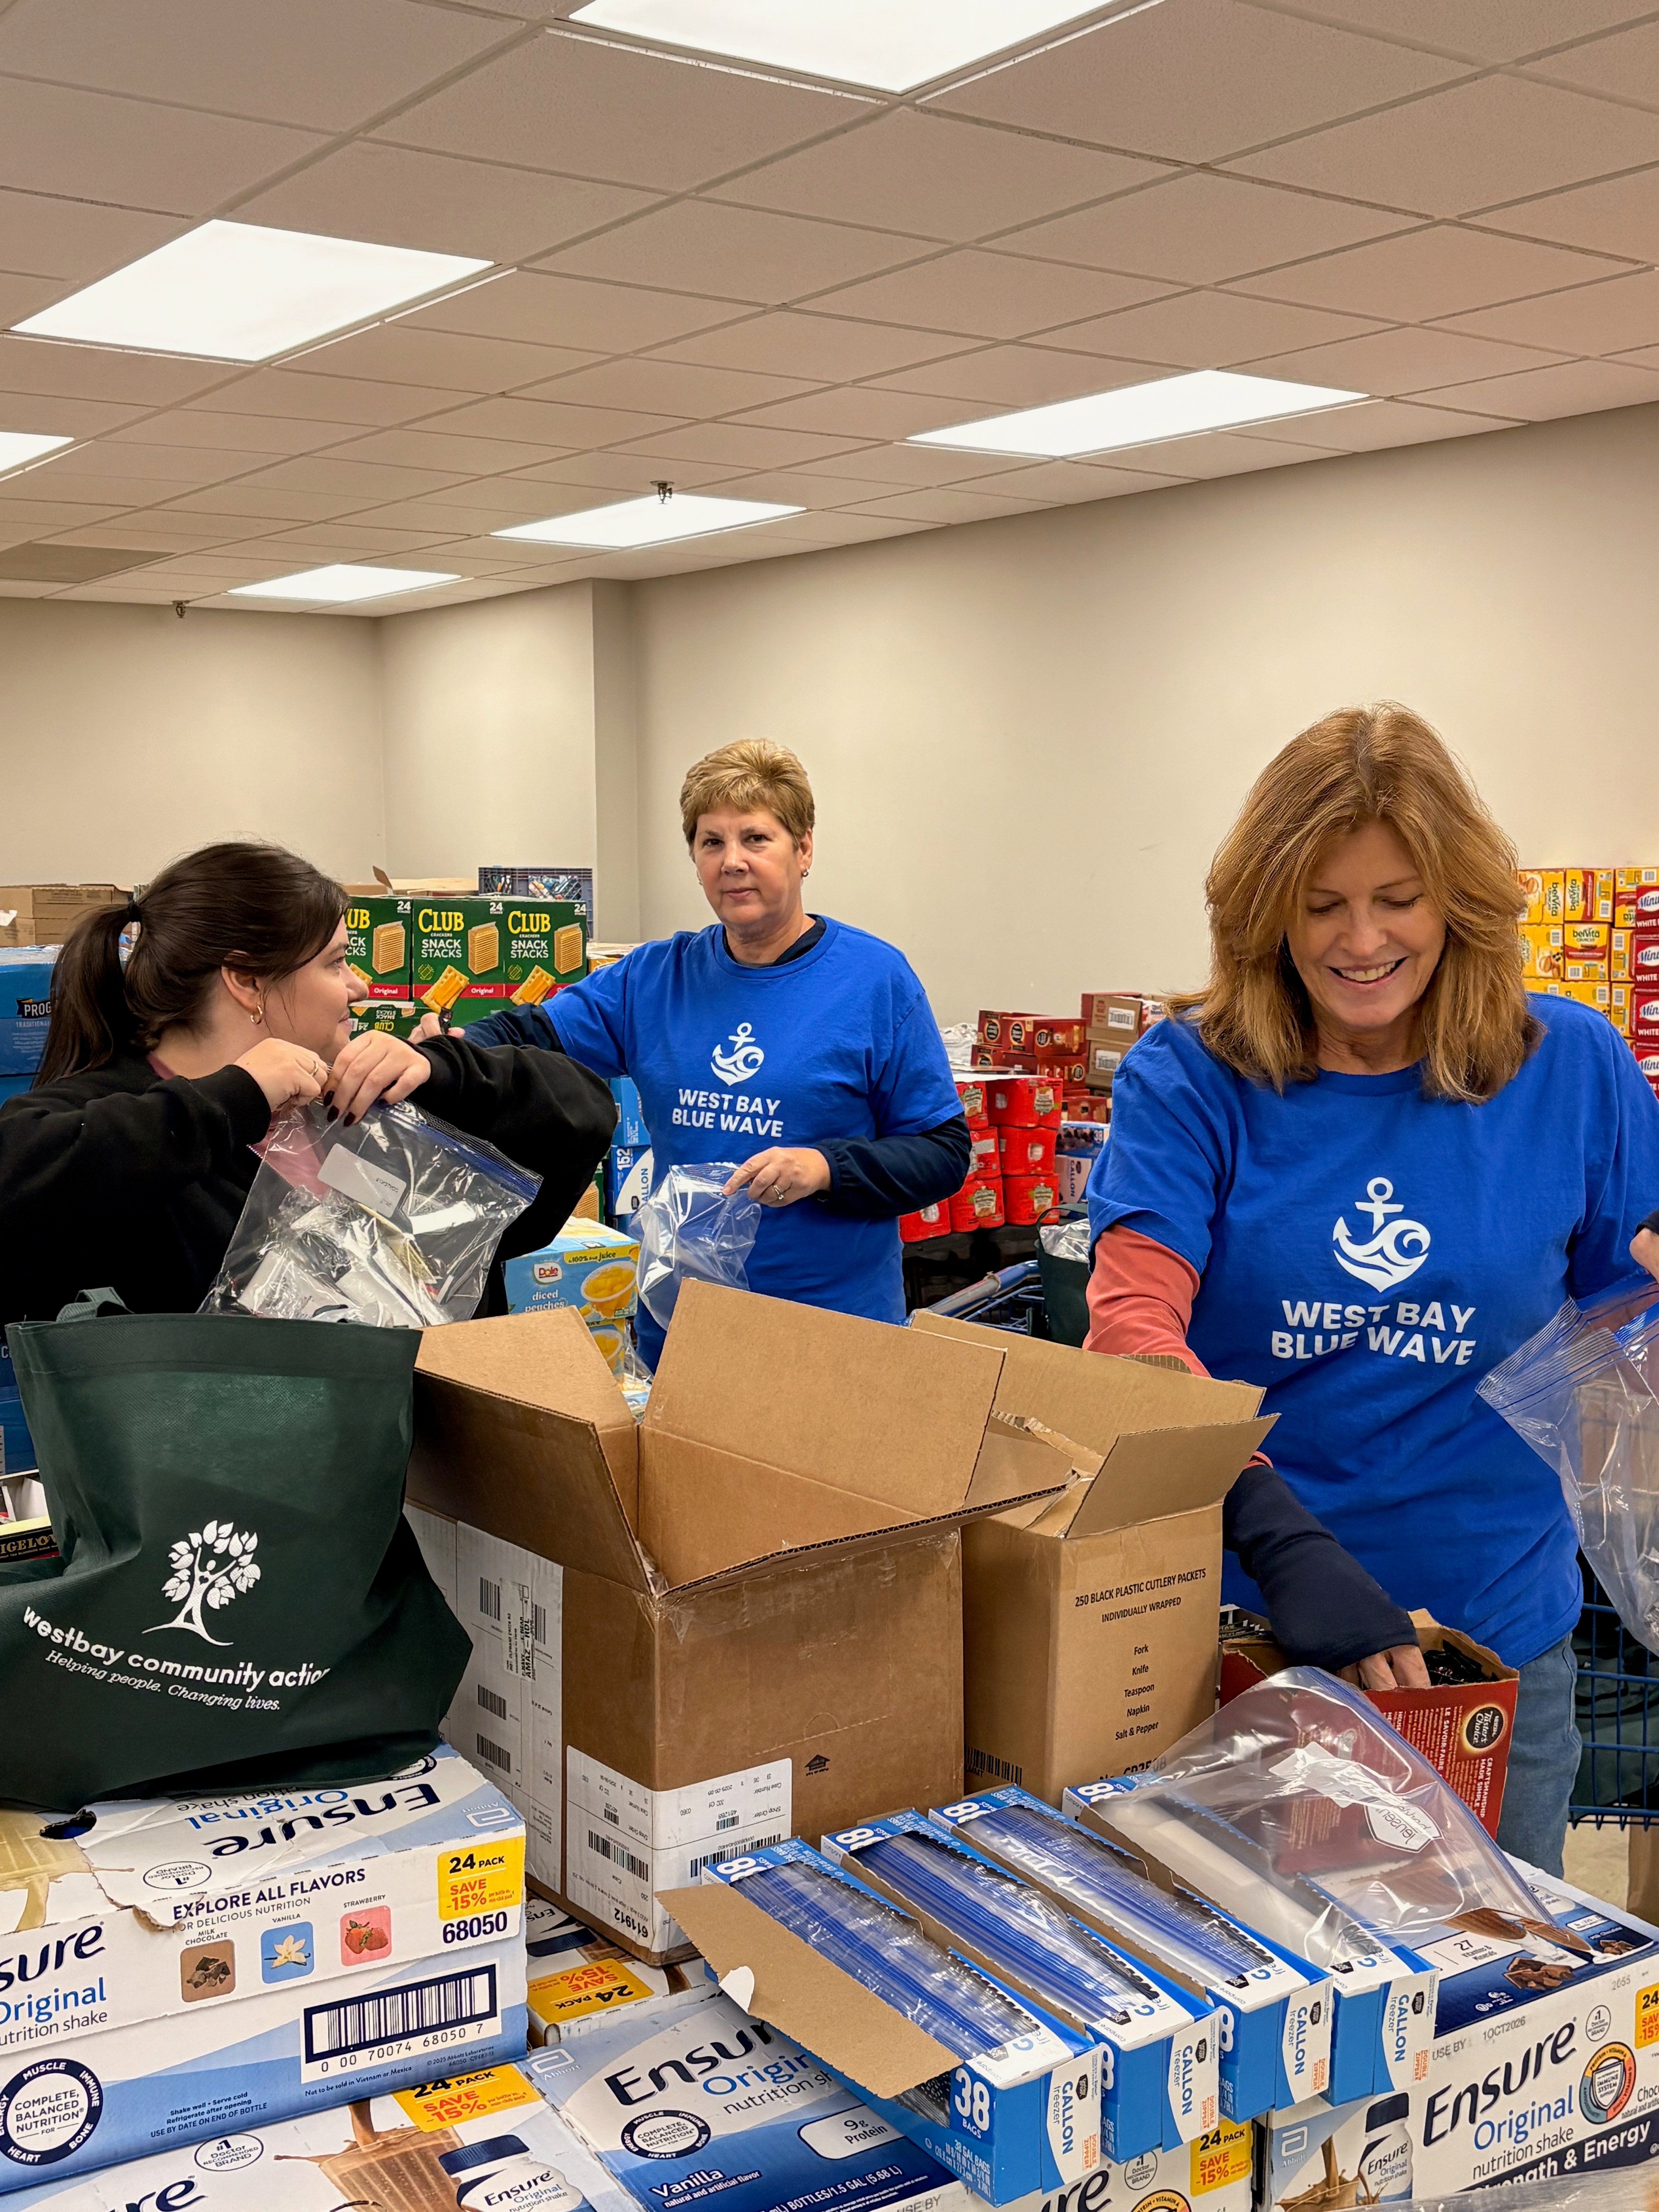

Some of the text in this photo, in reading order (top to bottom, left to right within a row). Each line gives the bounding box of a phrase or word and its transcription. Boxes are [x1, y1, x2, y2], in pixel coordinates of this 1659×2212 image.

[397, 901, 411, 910] 24
[1552, 882, 1561, 916] belVita
[1568, 879, 1577, 911] belVita
[489, 902, 503, 911] 24
[574, 904, 586, 912] 24
[418, 908, 464, 933] CLUB
[508, 911, 551, 934] CLUB
[1637, 919, 1657, 927] WHITE
[422, 939, 461, 948] SNACK
[1573, 927, 1600, 938] belVita
[421, 949, 462, 958] STACKS
[510, 950, 549, 958] STACKS
[511, 940, 548, 949] SNACK
[1636, 974, 1657, 982] WHITE
[374, 988, 398, 996] Original
[471, 988, 493, 996] Original
[374, 1022, 394, 1031] CLUB
[678, 1089, 781, 1116] WEST BAY
[672, 1108, 783, 1137] BLUE WAVE
[617, 1148, 630, 1170] 152
[539, 1266, 558, 1276] Dole
[525, 1300, 564, 1312] peaches
[532, 1290, 558, 1300] diced
[1282, 1300, 1476, 1333] WEST BAY
[1272, 1326, 1476, 1365] BLUE WAVE
[1075, 1568, 1206, 1607] 250 BLACK PLASTIC CUTLERY PACKETS
[1102, 1597, 1182, 1623] INDIVIDUALLY WRAPPED
[23, 1606, 124, 1666] westbay
[128, 1653, 266, 1692] community
[1134, 1644, 1149, 1655] Fork
[46, 1650, 281, 1712] Helping people. Changing lives.
[1132, 1664, 1149, 1676] Knife
[1124, 1683, 1154, 1698] Teaspoon
[1127, 1704, 1149, 1717] Napkin
[1115, 1722, 1158, 1740] Salt & Pepper
[1473, 1713, 1483, 1743] Choice
[1481, 1711, 1493, 1743] Taster's
[1438, 1707, 1451, 1771] LE SAVOIR-FAIRE
[1474, 1781, 1483, 1807] SIMPLE
[1480, 1757, 1493, 1817] CRAFTSMANSHIP
[185, 1790, 348, 1829] Original
[201, 1784, 441, 1856] Ensure
[768, 1806, 781, 1814] Shop
[449, 1854, 505, 1874] 24 PACK
[173, 1868, 366, 1920] EXPLORE ALL FLAVORS
[450, 1879, 487, 1895] SAVE
[343, 1894, 386, 1908] STRAWBERRY
[272, 1913, 301, 1923] VANILLA
[443, 1911, 508, 1944] 68050
[614, 1908, 648, 1938] 611912
[185, 1931, 228, 1946] CHOCOLATE
[199, 1929, 215, 1937] MILK
[1454, 1940, 1474, 1951] 27
[568, 1974, 618, 1992] SAVE
[555, 1984, 634, 2009] 24 PACK
[1388, 1997, 1398, 2032] freezer
[1395, 1994, 1410, 2062] GALLON
[321, 2024, 483, 2072] 0 00 70074 68050 7
[1295, 2006, 1307, 2076] GALLON
[23, 2062, 66, 2081] MUSCLE
[305, 2089, 317, 2097] Not
[335, 2080, 347, 2089] sold
[356, 2072, 382, 2084] Vietnam
[391, 2066, 412, 2076] Mexico
[1182, 2045, 1192, 2116] GALLON
[79, 2070, 100, 2107] IMMUNE
[411, 2070, 496, 2098] 24 PACK
[1423, 2022, 1577, 2147] Ensure
[1598, 2081, 1617, 2094] SYSTEM
[15, 2089, 79, 2111] COMPLETE,
[170, 2092, 248, 2116] Shake well Serve cold
[424, 2091, 480, 2112] SAVE
[723, 2078, 812, 2115] nutrition
[955, 2068, 989, 2131] 38
[16, 2100, 79, 2122] BALANCED
[151, 2102, 267, 2138] USE BY DATE ON END OF BOTTLE
[167, 2099, 252, 2125] Refrigerate after opening
[633, 2111, 664, 2124] MUSCLE
[679, 2112, 705, 2128] IMMUNE
[1062, 2081, 1073, 2155] GALLON
[1474, 2085, 1574, 2150] Original
[69, 2123, 93, 2150] BONE
[641, 2126, 689, 2143] BALANCED
[844, 2125, 888, 2145] Protein
[962, 2118, 982, 2139] BAGS
[211, 2145, 246, 2158] Doctor
[216, 2140, 232, 2151] #1
[1200, 2129, 1245, 2152] 24 PACK
[1564, 2121, 1650, 2170] & Energy
[8, 2146, 41, 2162] HEART
[203, 2146, 259, 2165] RECOMMENDED
[215, 2153, 252, 2167] BRAND
[1200, 2151, 1230, 2171] SAVE
[1368, 2142, 1408, 2175] Ensure
[1473, 2143, 1533, 2180] nutrition
[1536, 2126, 1574, 2154] shake
[1132, 2164, 1149, 2174] Doctor
[1380, 2159, 1407, 2176] Original
[484, 2172, 554, 2206] Ensure
[652, 2169, 725, 2198] Vanilla
[664, 2170, 761, 2207] natural and artificial flavor
[1132, 2173, 1150, 2185] BRAND
[514, 2184, 563, 2203] Original
